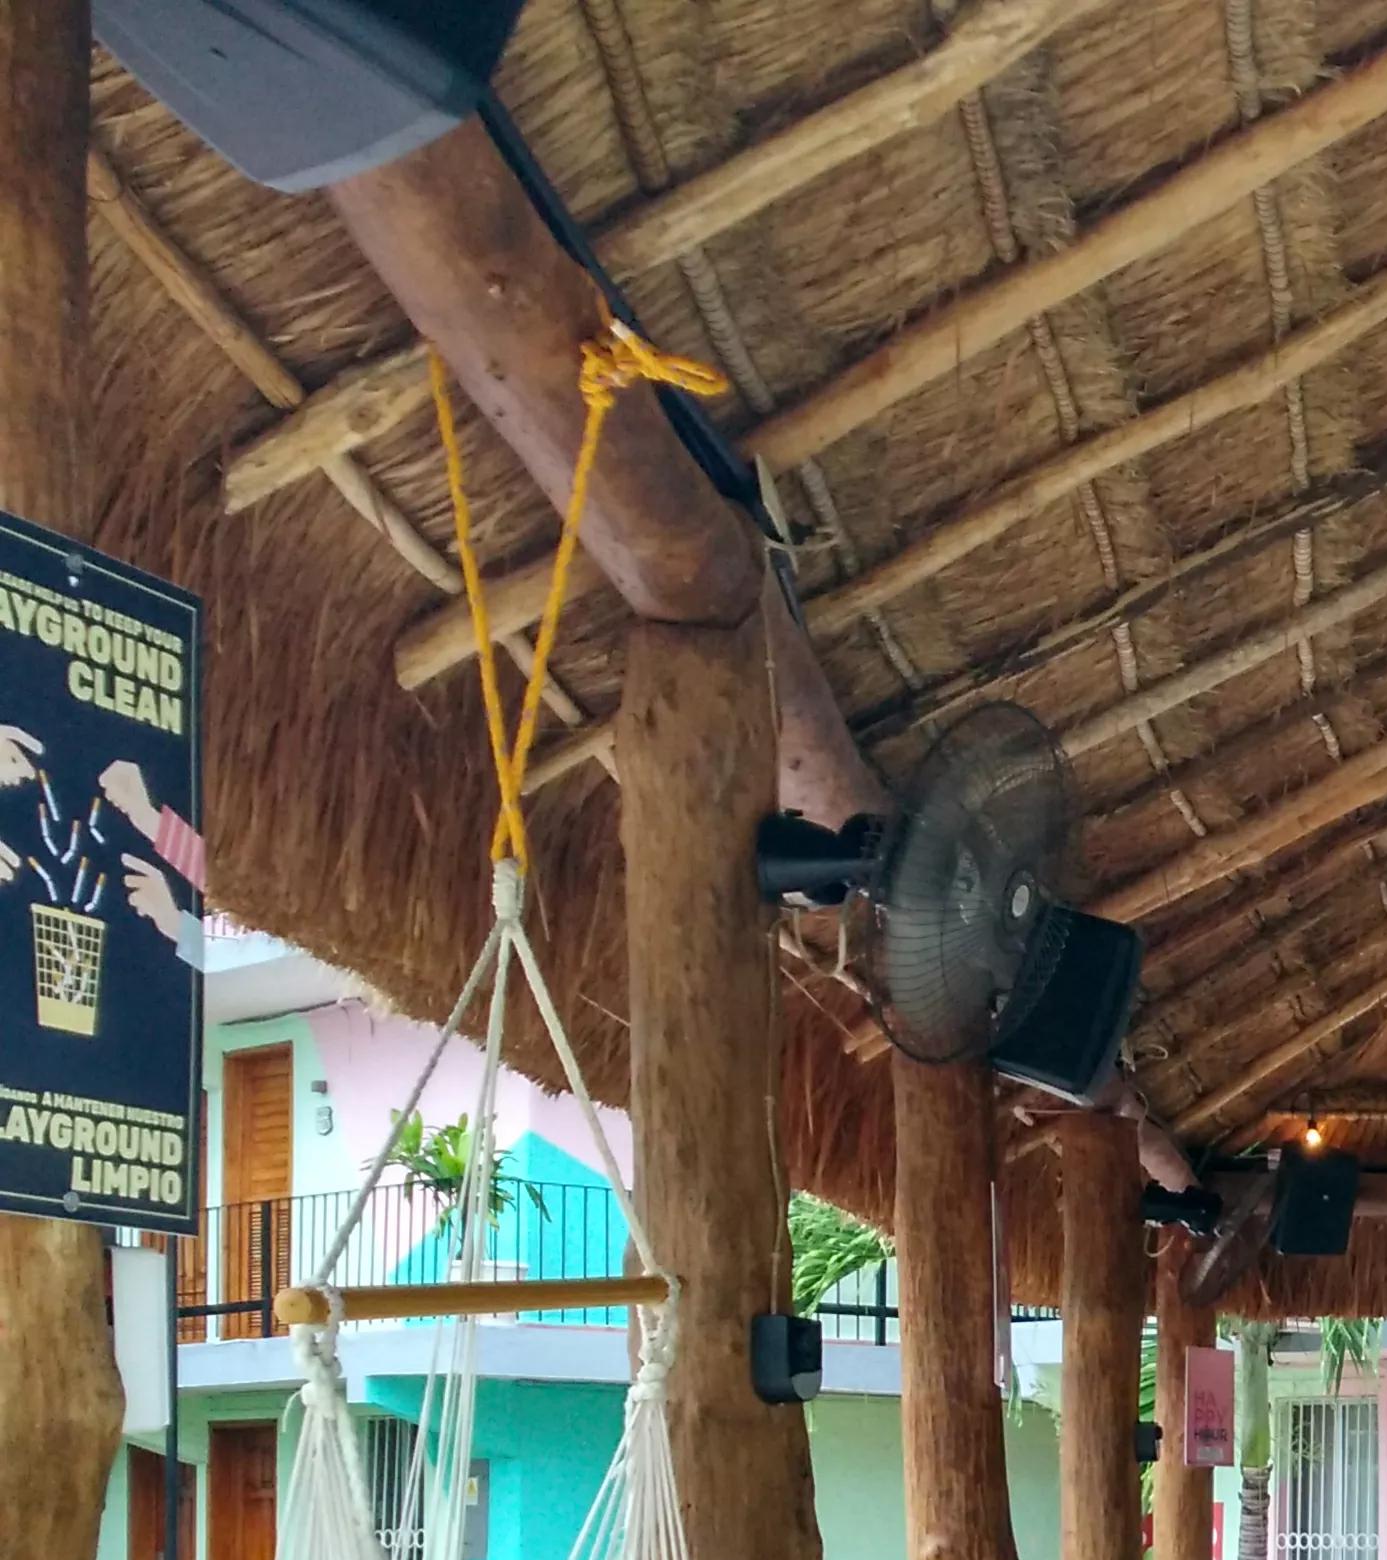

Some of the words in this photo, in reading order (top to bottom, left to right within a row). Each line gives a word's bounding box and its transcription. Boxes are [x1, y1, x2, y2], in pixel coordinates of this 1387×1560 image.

[82, 600, 102, 622] TO
[105, 608, 143, 637] KEEP
[68, 660, 182, 734] CLEAN
[53, 1093, 125, 1118] MANTENER
[71, 1156, 182, 1204] LIMPIO
